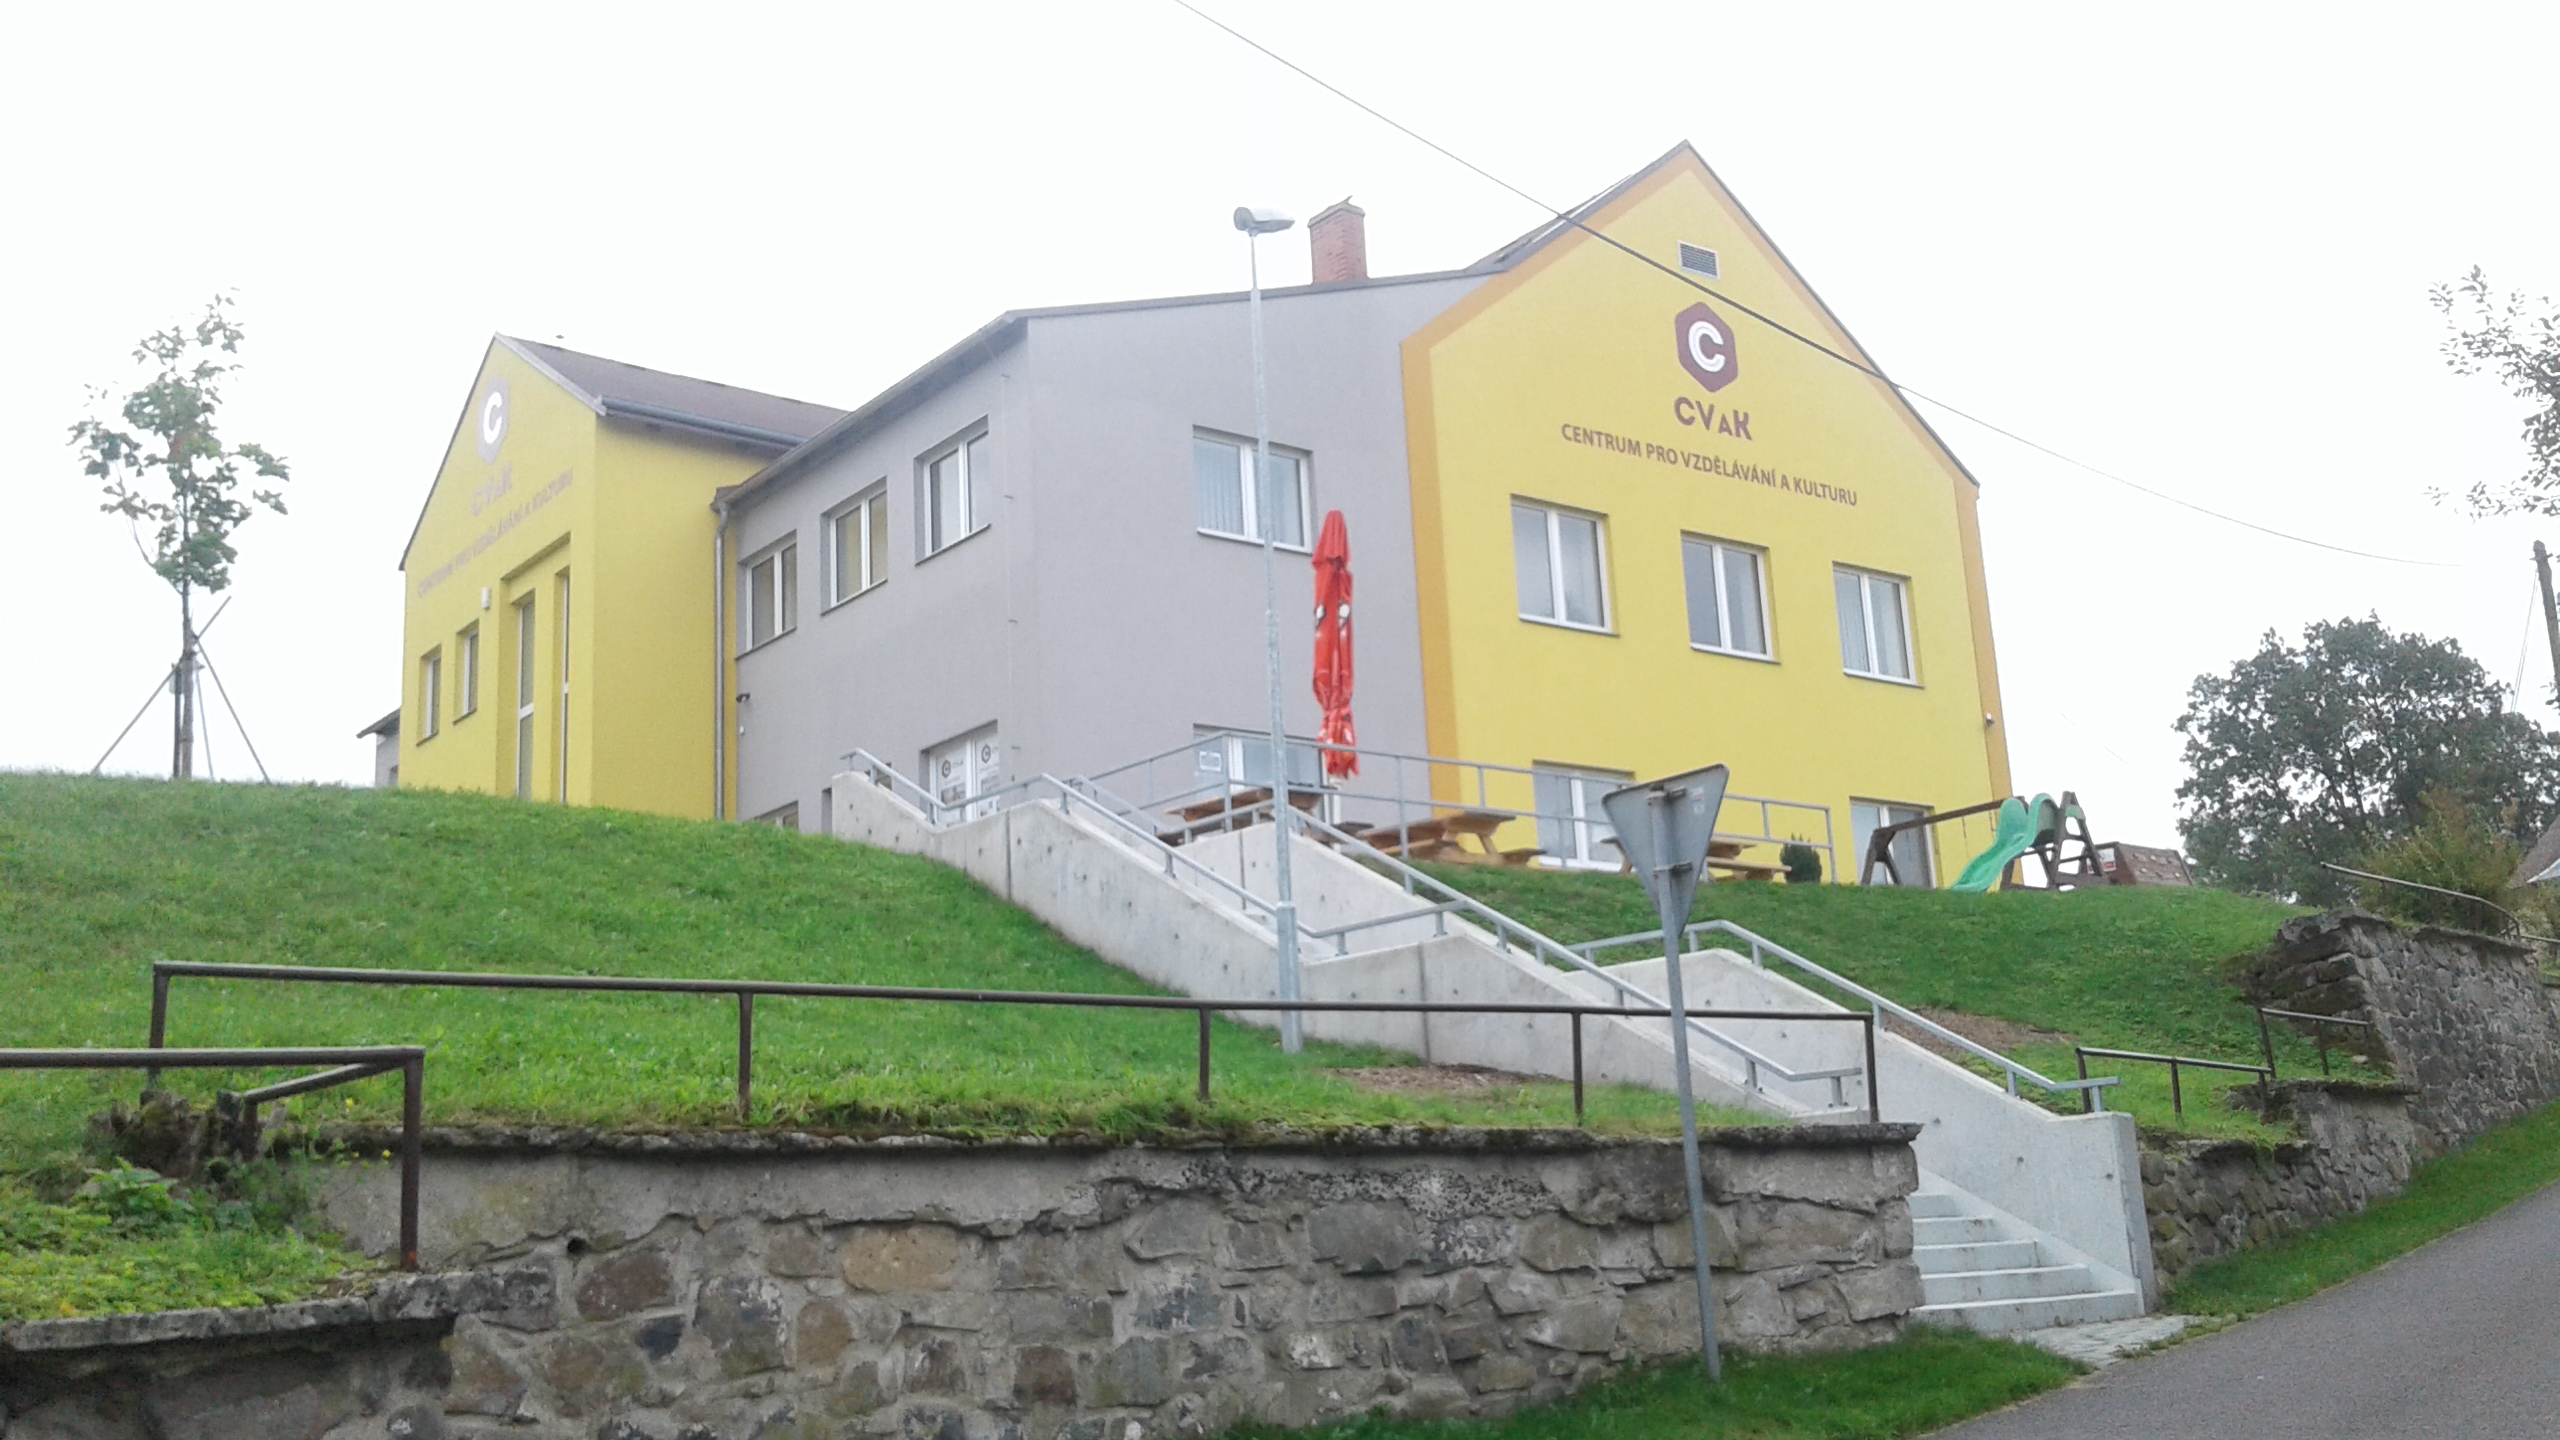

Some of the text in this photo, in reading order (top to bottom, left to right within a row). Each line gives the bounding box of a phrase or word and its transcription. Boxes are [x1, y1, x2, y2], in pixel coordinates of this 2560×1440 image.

[1688, 321, 1725, 372] C
[1673, 396, 1753, 441] CVAK
[1561, 423, 1858, 507] CENTRUM PRO VZDĚLÁVÁNÍ A KULTURU
